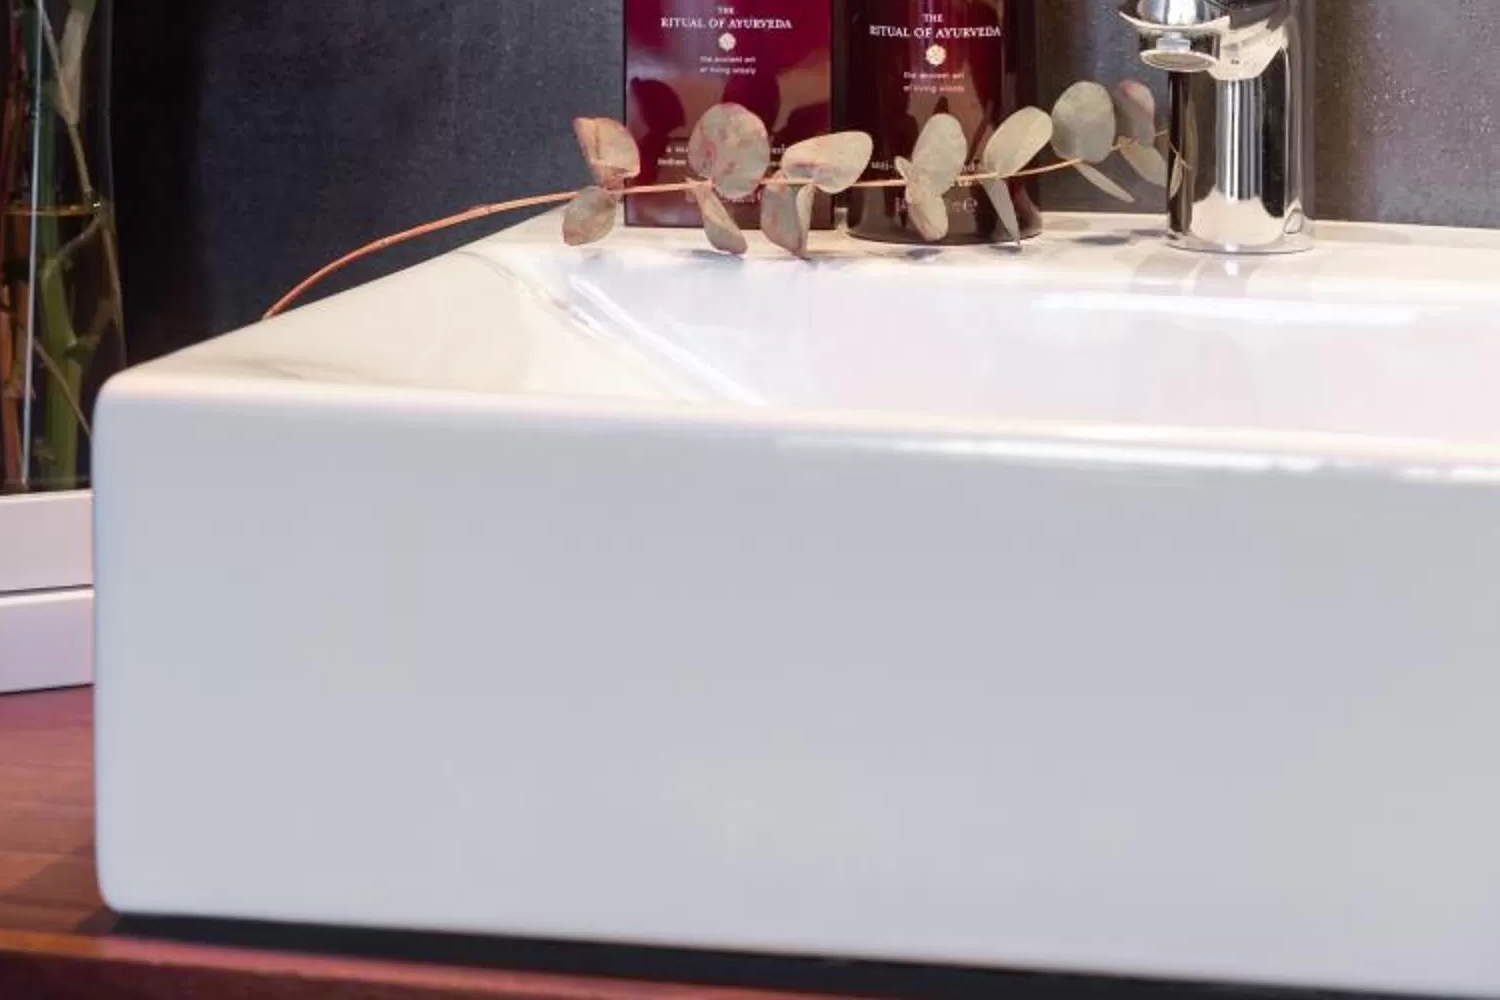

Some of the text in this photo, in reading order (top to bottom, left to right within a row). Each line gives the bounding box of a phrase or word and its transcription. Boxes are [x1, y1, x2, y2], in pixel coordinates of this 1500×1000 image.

[717, 6, 735, 15] THE
[660, 17, 793, 30] RITUAL OF AYURVEDA
[923, 13, 943, 23] THE
[869, 24, 1002, 39] RITUAL OF AYURVEDA
